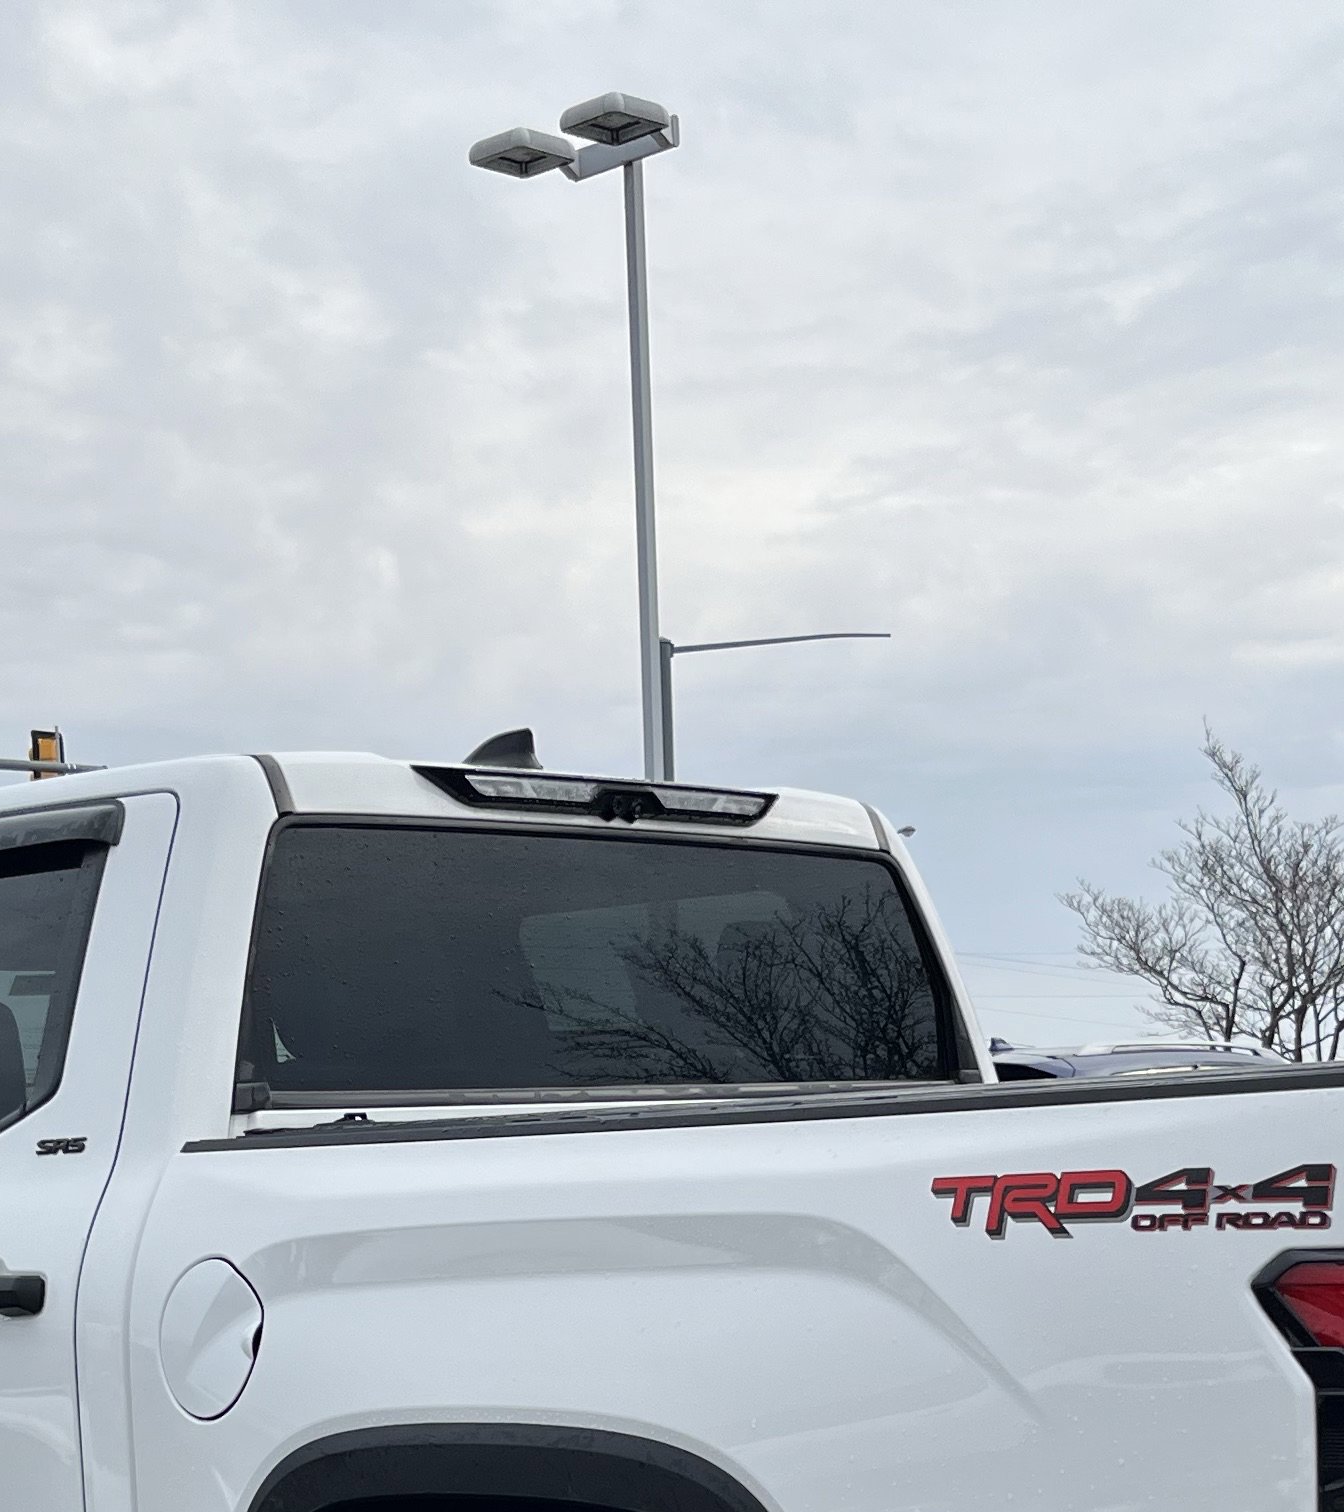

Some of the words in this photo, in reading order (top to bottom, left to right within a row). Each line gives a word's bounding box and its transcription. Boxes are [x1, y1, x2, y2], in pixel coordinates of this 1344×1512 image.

[931, 1169, 1136, 1240] TRD
[1130, 1212, 1209, 1231] OFF
[1215, 1210, 1333, 1231] ROAD
